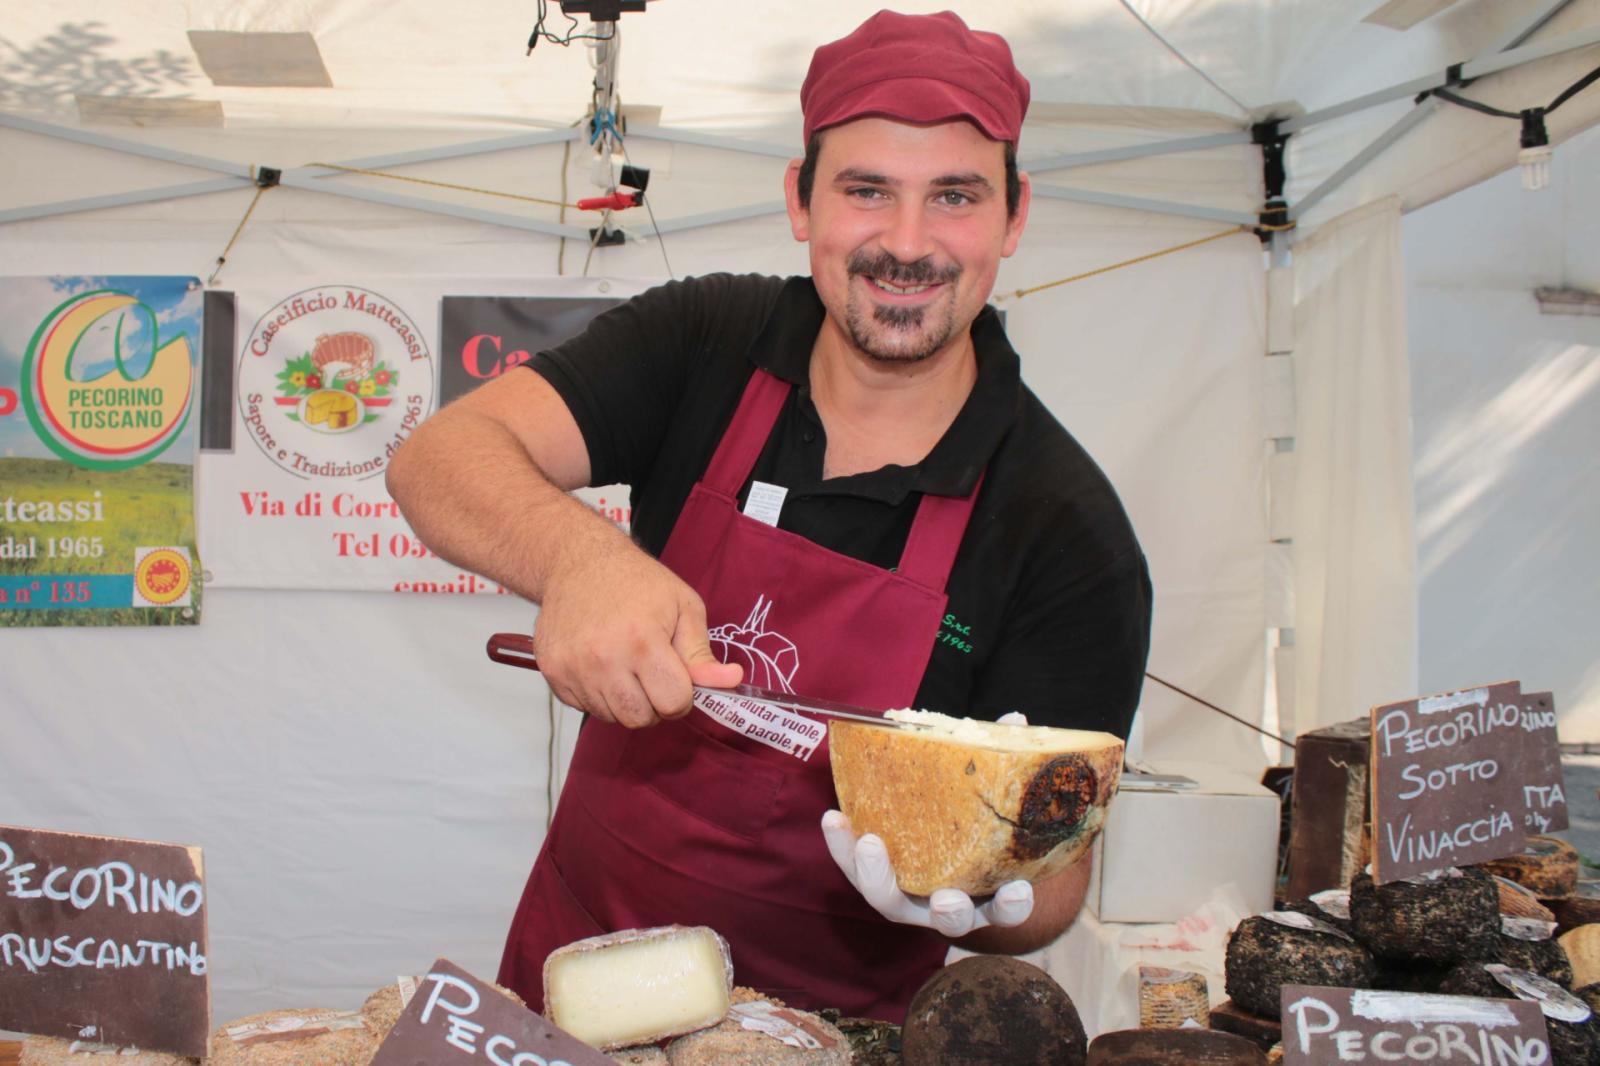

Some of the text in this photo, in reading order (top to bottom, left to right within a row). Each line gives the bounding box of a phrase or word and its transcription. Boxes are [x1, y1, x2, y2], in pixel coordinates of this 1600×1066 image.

[251, 290, 428, 362] Caseificio Matteassi
[68, 387, 163, 407] PECORINO
[69, 409, 163, 429] TOSCANO
[248, 393, 277, 450] Sapore
[277, 448, 288, 461] e
[291, 452, 384, 477] Tradizione
[401, 394, 423, 431] 1965
[0, 490, 104, 521] teassi
[239, 491, 286, 516] Via
[295, 492, 321, 516] di
[47, 536, 103, 558] 1965
[334, 532, 379, 557] Tel
[49, 582, 92, 602] 135
[942, 633, 974, 653] 1965
[702, 694, 729, 716] fatti
[725, 710, 746, 728] che
[781, 716, 820, 742] vuole,
[1376, 703, 1520, 757] PECORINO
[1398, 759, 1498, 800] SOTTO
[1386, 803, 1514, 864] VINACCIA
[1288, 996, 1549, 1066] PECORINO
